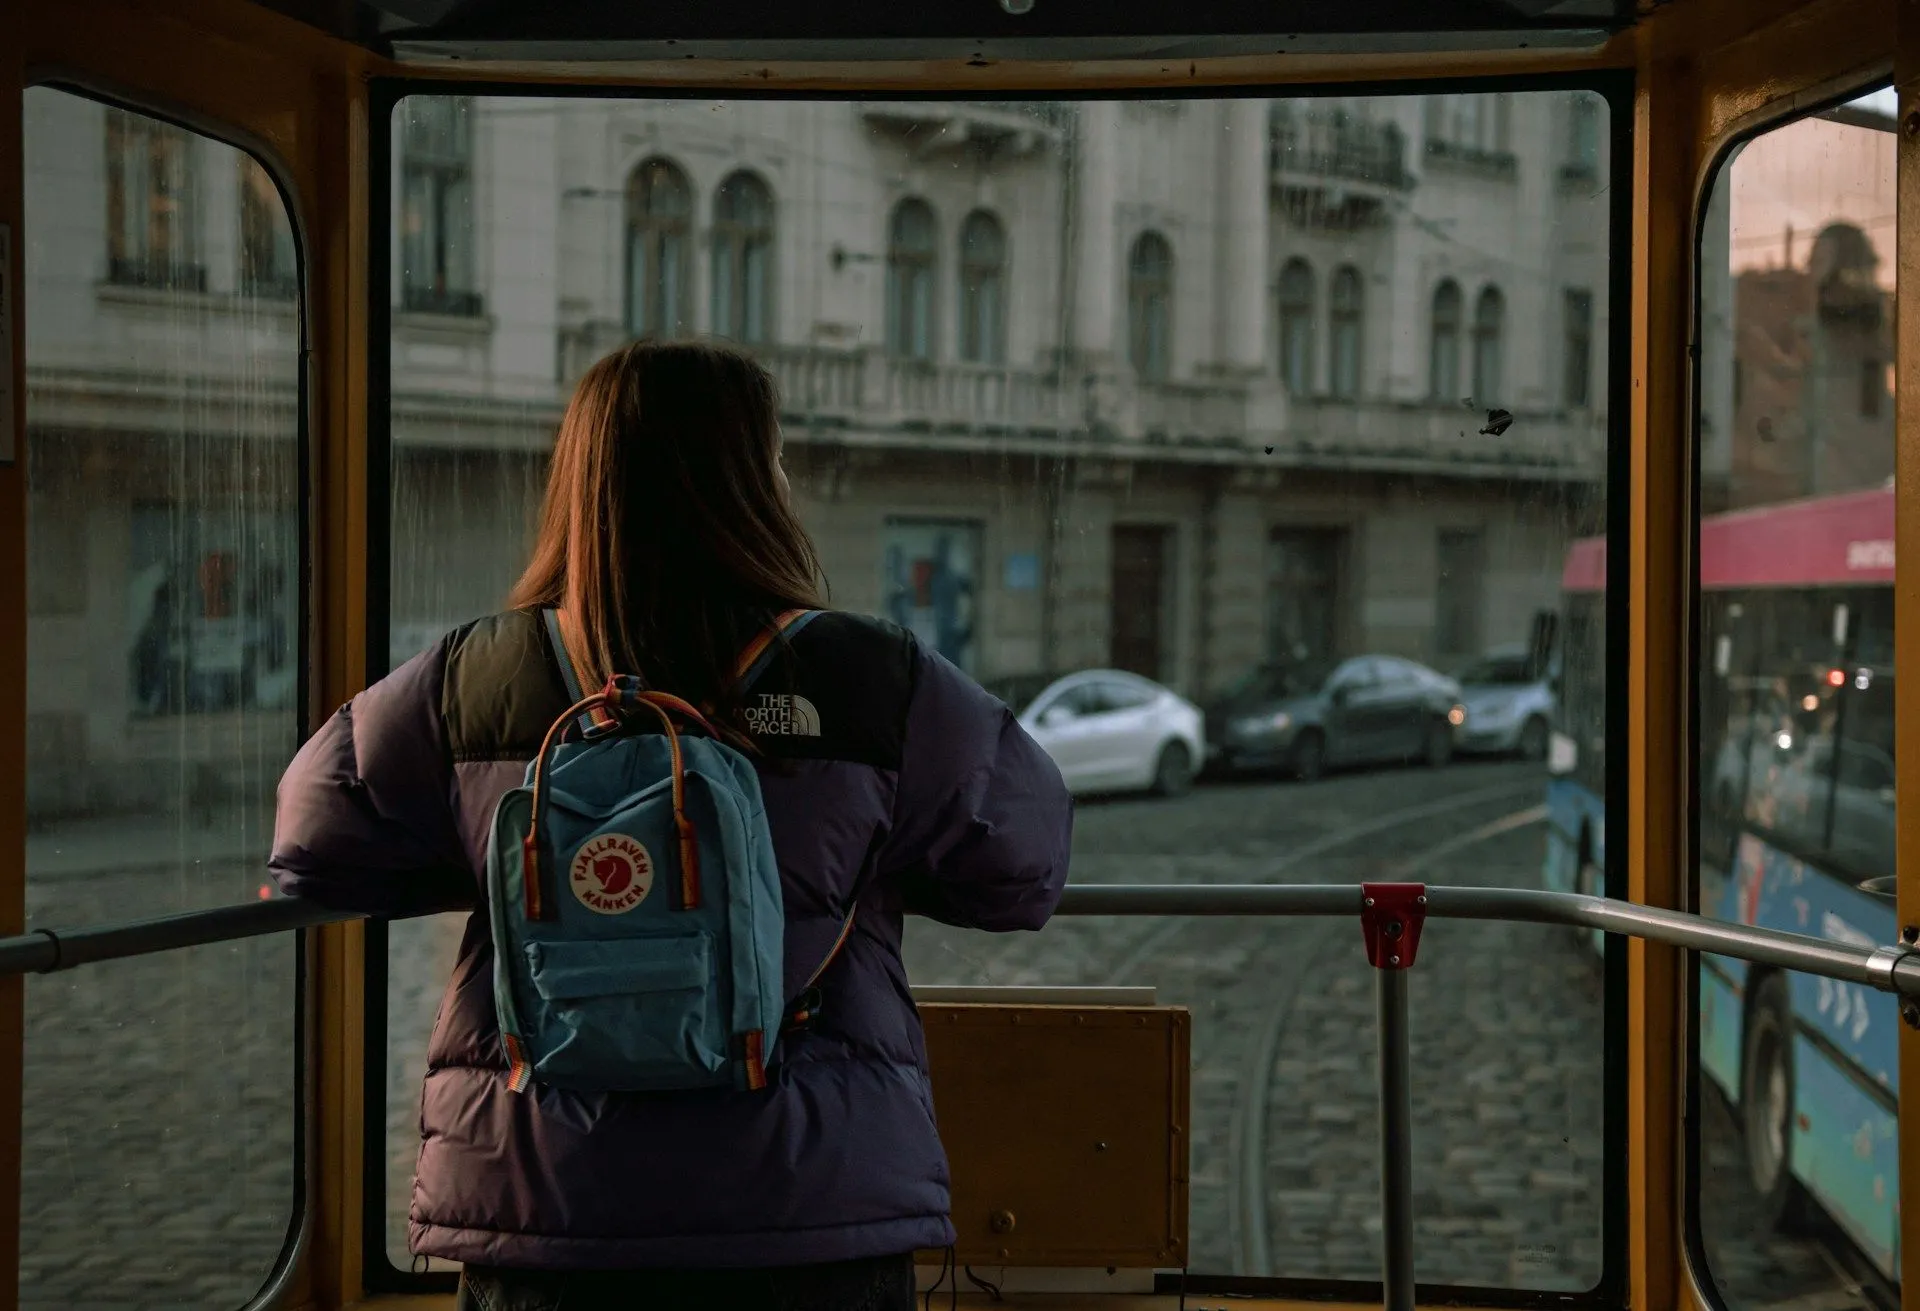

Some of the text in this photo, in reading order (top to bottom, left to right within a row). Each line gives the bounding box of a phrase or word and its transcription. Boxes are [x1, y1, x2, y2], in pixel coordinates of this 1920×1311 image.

[758, 694, 791, 708] THE
[745, 707, 791, 721] ORTH
[750, 720, 791, 735] FACE
